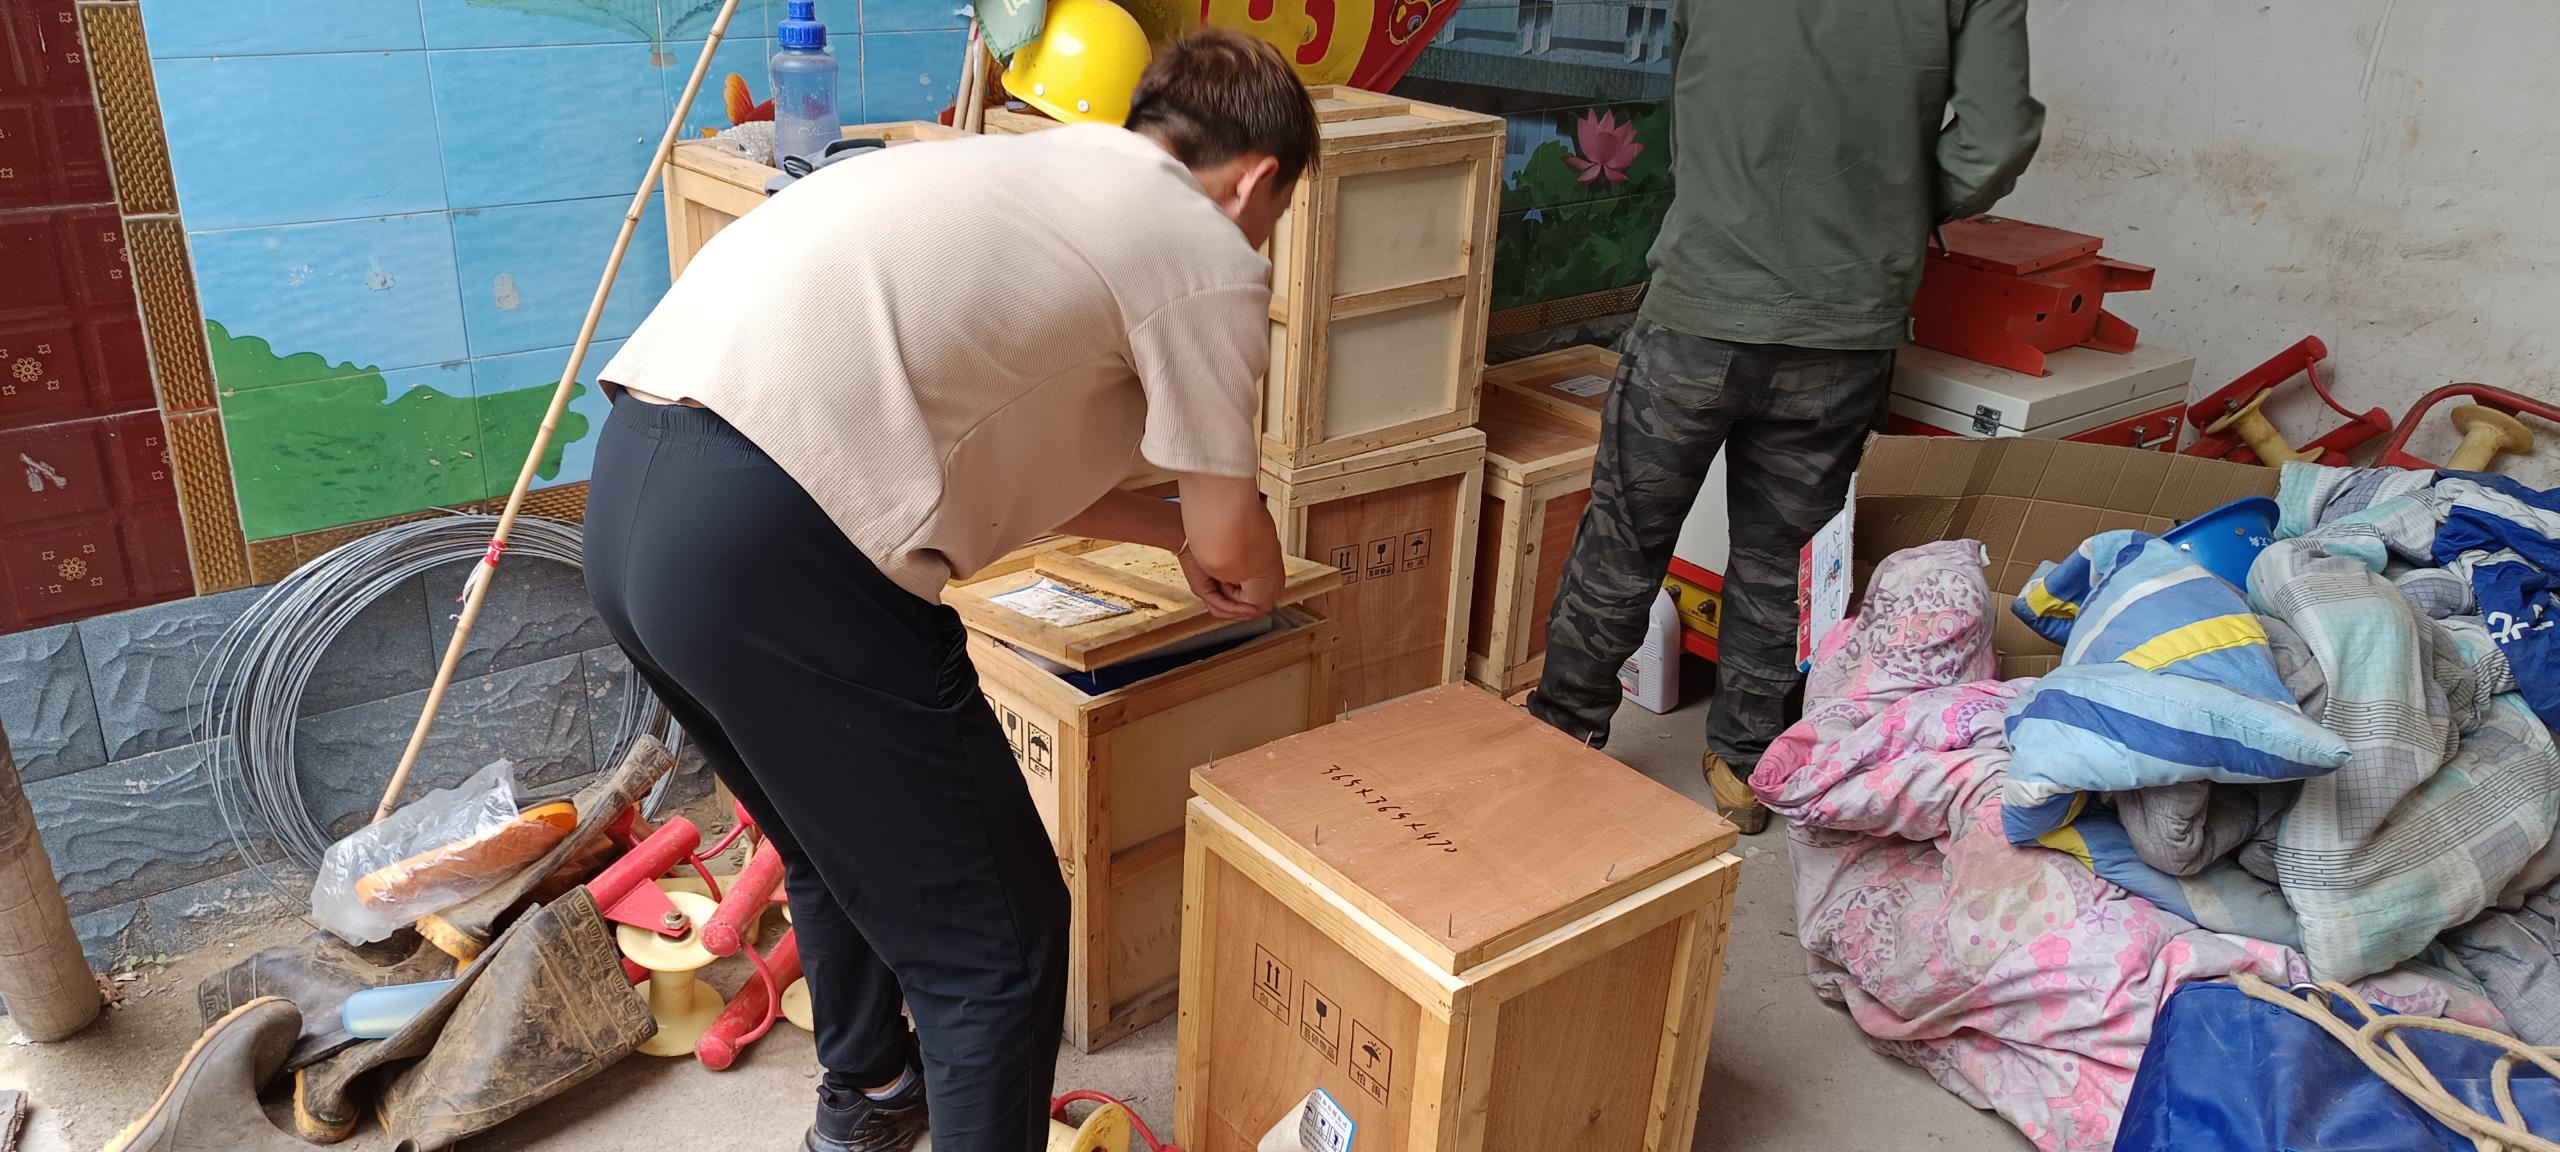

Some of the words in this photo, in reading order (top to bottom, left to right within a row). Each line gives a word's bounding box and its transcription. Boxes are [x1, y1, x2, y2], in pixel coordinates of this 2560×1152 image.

[1304, 1026, 1335, 1061] 易碎物品
[1356, 1070, 1381, 1098] 怕雨
